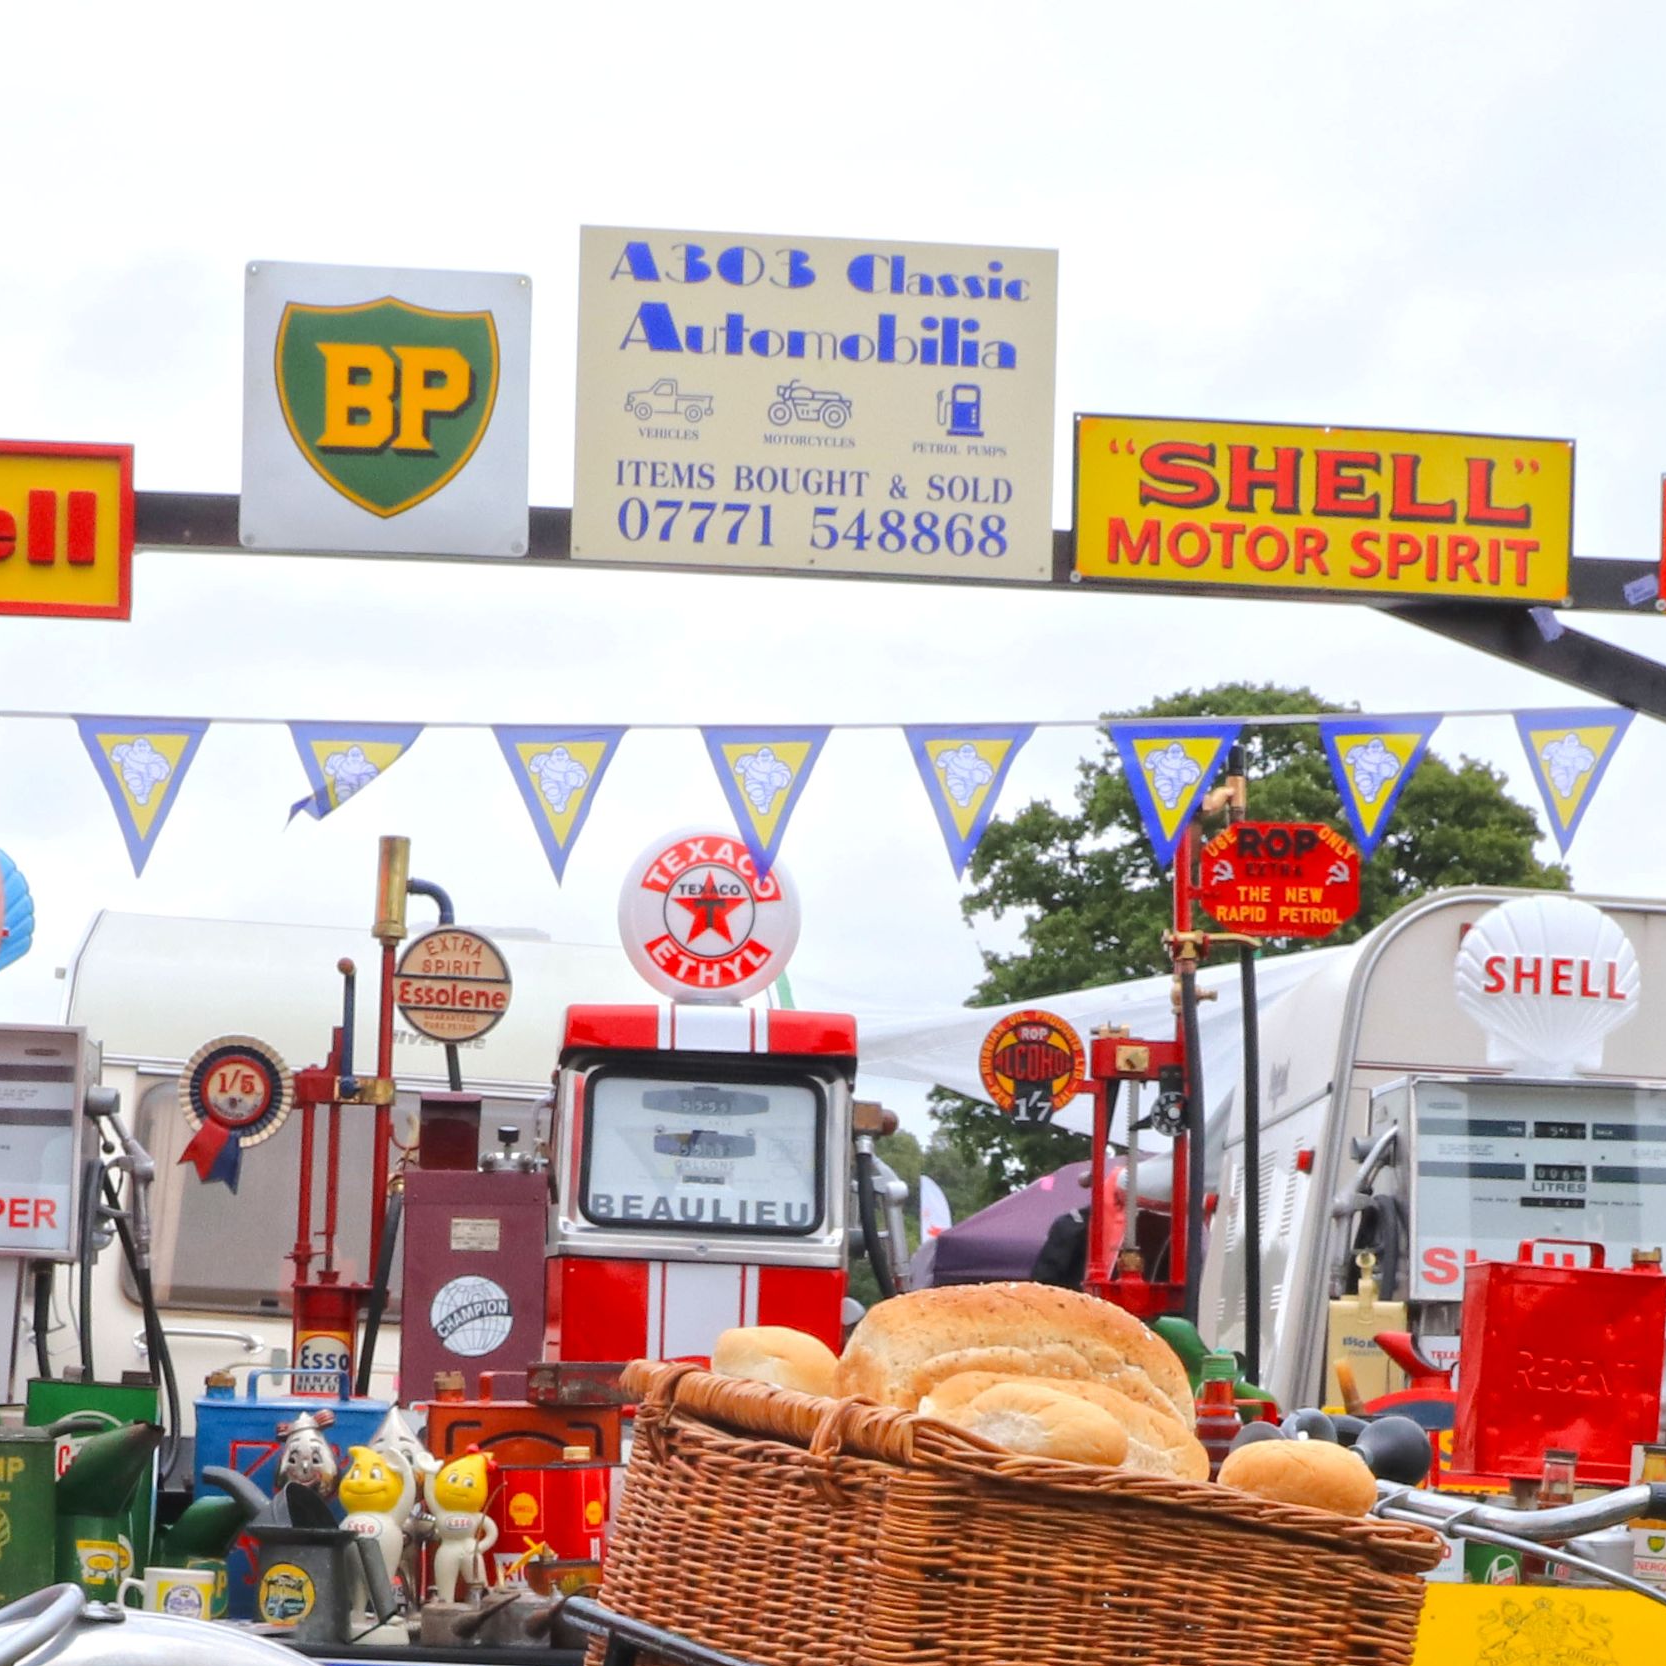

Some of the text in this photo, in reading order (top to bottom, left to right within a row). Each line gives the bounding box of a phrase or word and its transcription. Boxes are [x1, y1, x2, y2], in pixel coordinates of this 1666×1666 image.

[609, 241, 1031, 304] A303 Classic
[619, 302, 1017, 370] Automobilia
[316, 343, 475, 454] BP
[637, 427, 699, 441] VEHICLES
[763, 433, 856, 449] MOTORCYCLES
[912, 441, 1007, 457] PETROL PUMPS
[616, 460, 1014, 506] ITEMS BOUGHT & SOLD
[617, 498, 1008, 558] 07771 548868
[1106, 516, 1540, 587] MOTOR SPIRIT
[1206, 826, 1356, 859] USE ROP ONLY
[646, 839, 776, 899] TEXACO
[1237, 886, 1323, 903] THE NEW
[1216, 905, 1344, 924] RAPID PETROL
[424, 936, 484, 958] EXTRA
[650, 939, 768, 986] ETHYL
[422, 959, 482, 975] SPIRIT
[1483, 955, 1627, 1001] SHELL
[398, 980, 507, 1009] Essolene
[1020, 1028, 1049, 1041] ROP
[218, 1069, 256, 1094] 1/5
[1532, 1182, 1586, 1194] LITRES
[591, 1193, 809, 1228] BEAULIEU
[435, 1299, 509, 1339] CHAMPION
